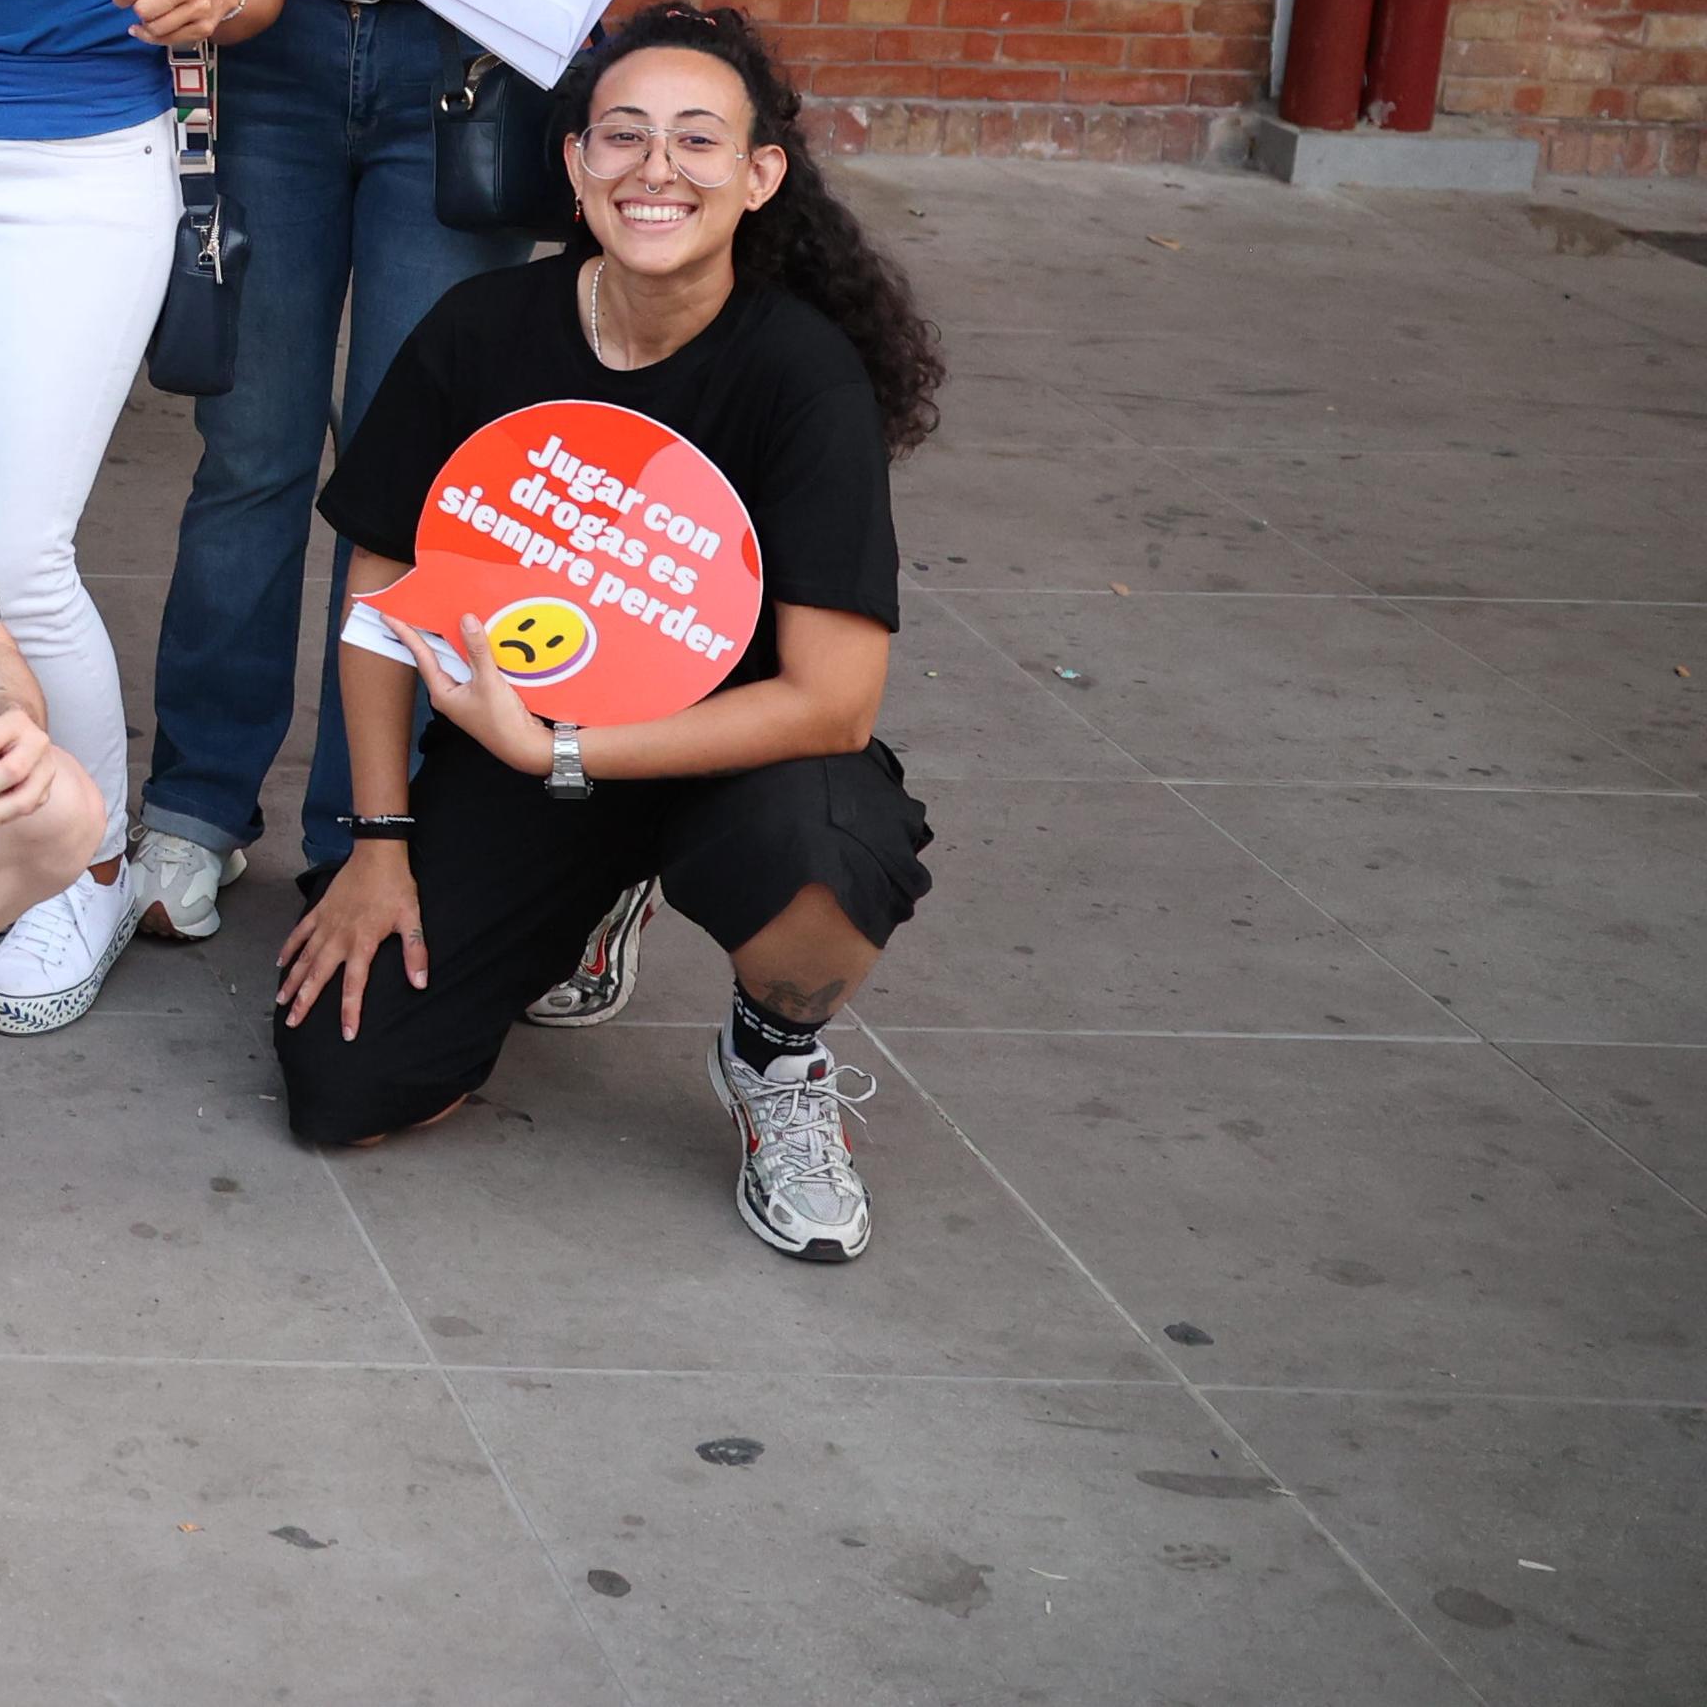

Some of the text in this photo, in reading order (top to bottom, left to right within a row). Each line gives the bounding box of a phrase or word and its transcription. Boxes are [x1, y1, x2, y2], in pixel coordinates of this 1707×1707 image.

[509, 473, 699, 596] drogas es
[527, 434, 723, 561] Jugar con
[437, 485, 736, 662] siempre perder
